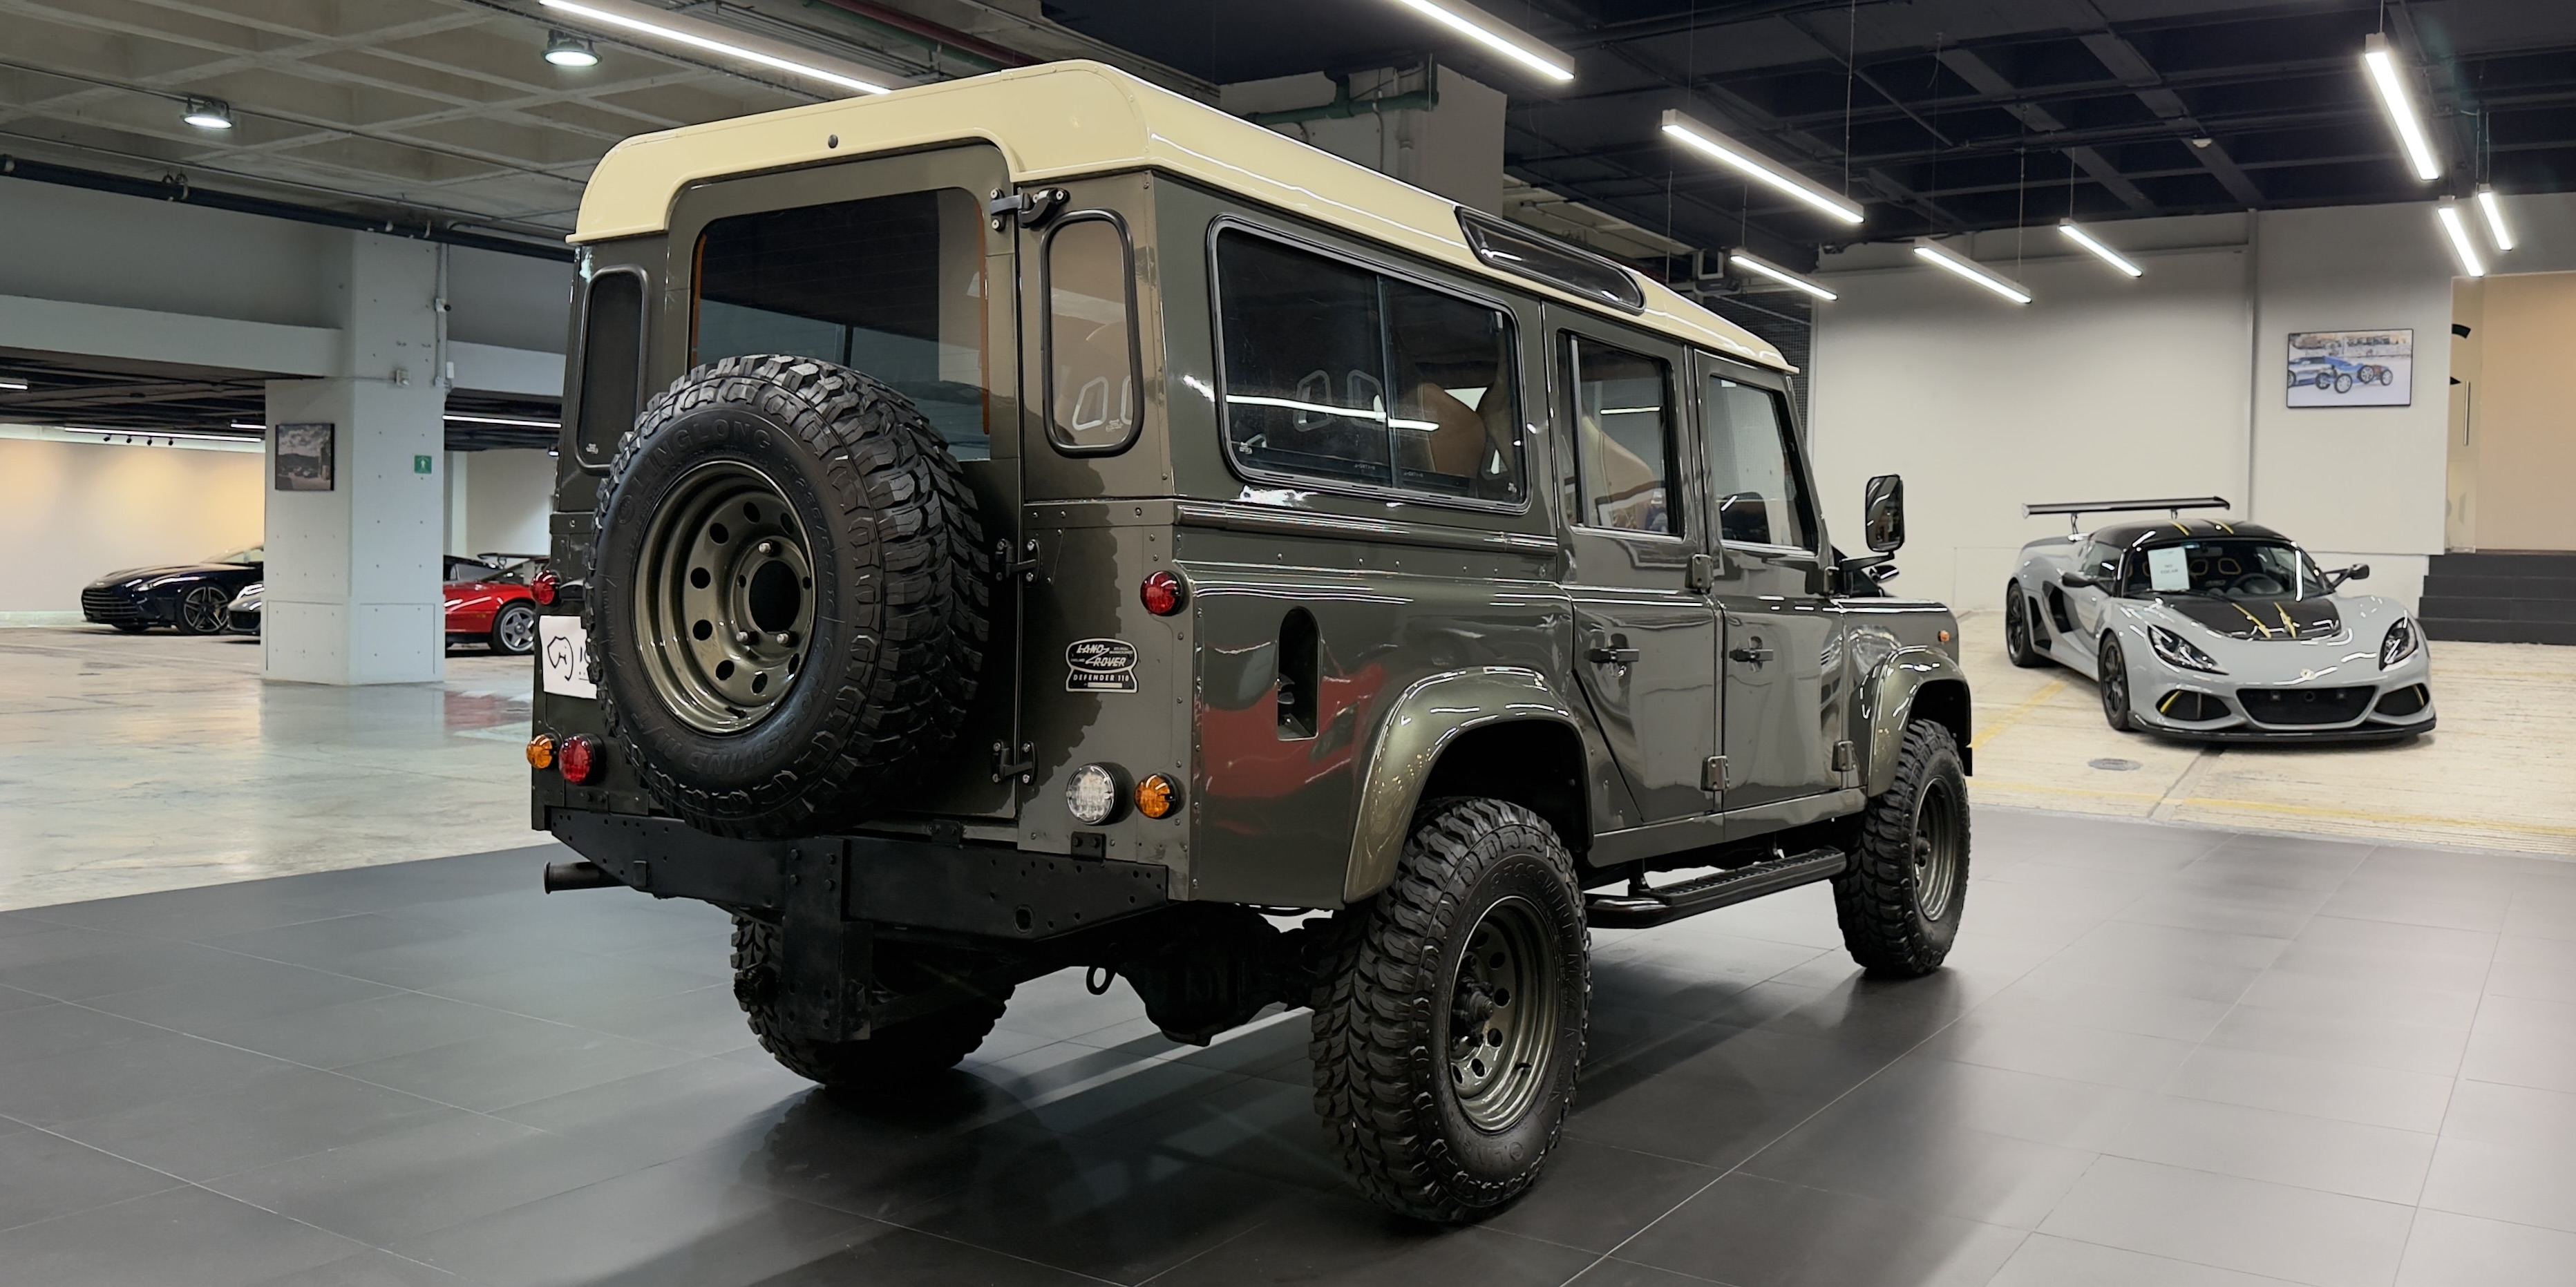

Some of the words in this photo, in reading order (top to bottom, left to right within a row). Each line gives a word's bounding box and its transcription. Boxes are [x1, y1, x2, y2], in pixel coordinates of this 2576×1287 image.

[631, 419, 772, 494] LINGLONG
[1076, 644, 1106, 654] LAND
[1092, 657, 1127, 667] ROVER
